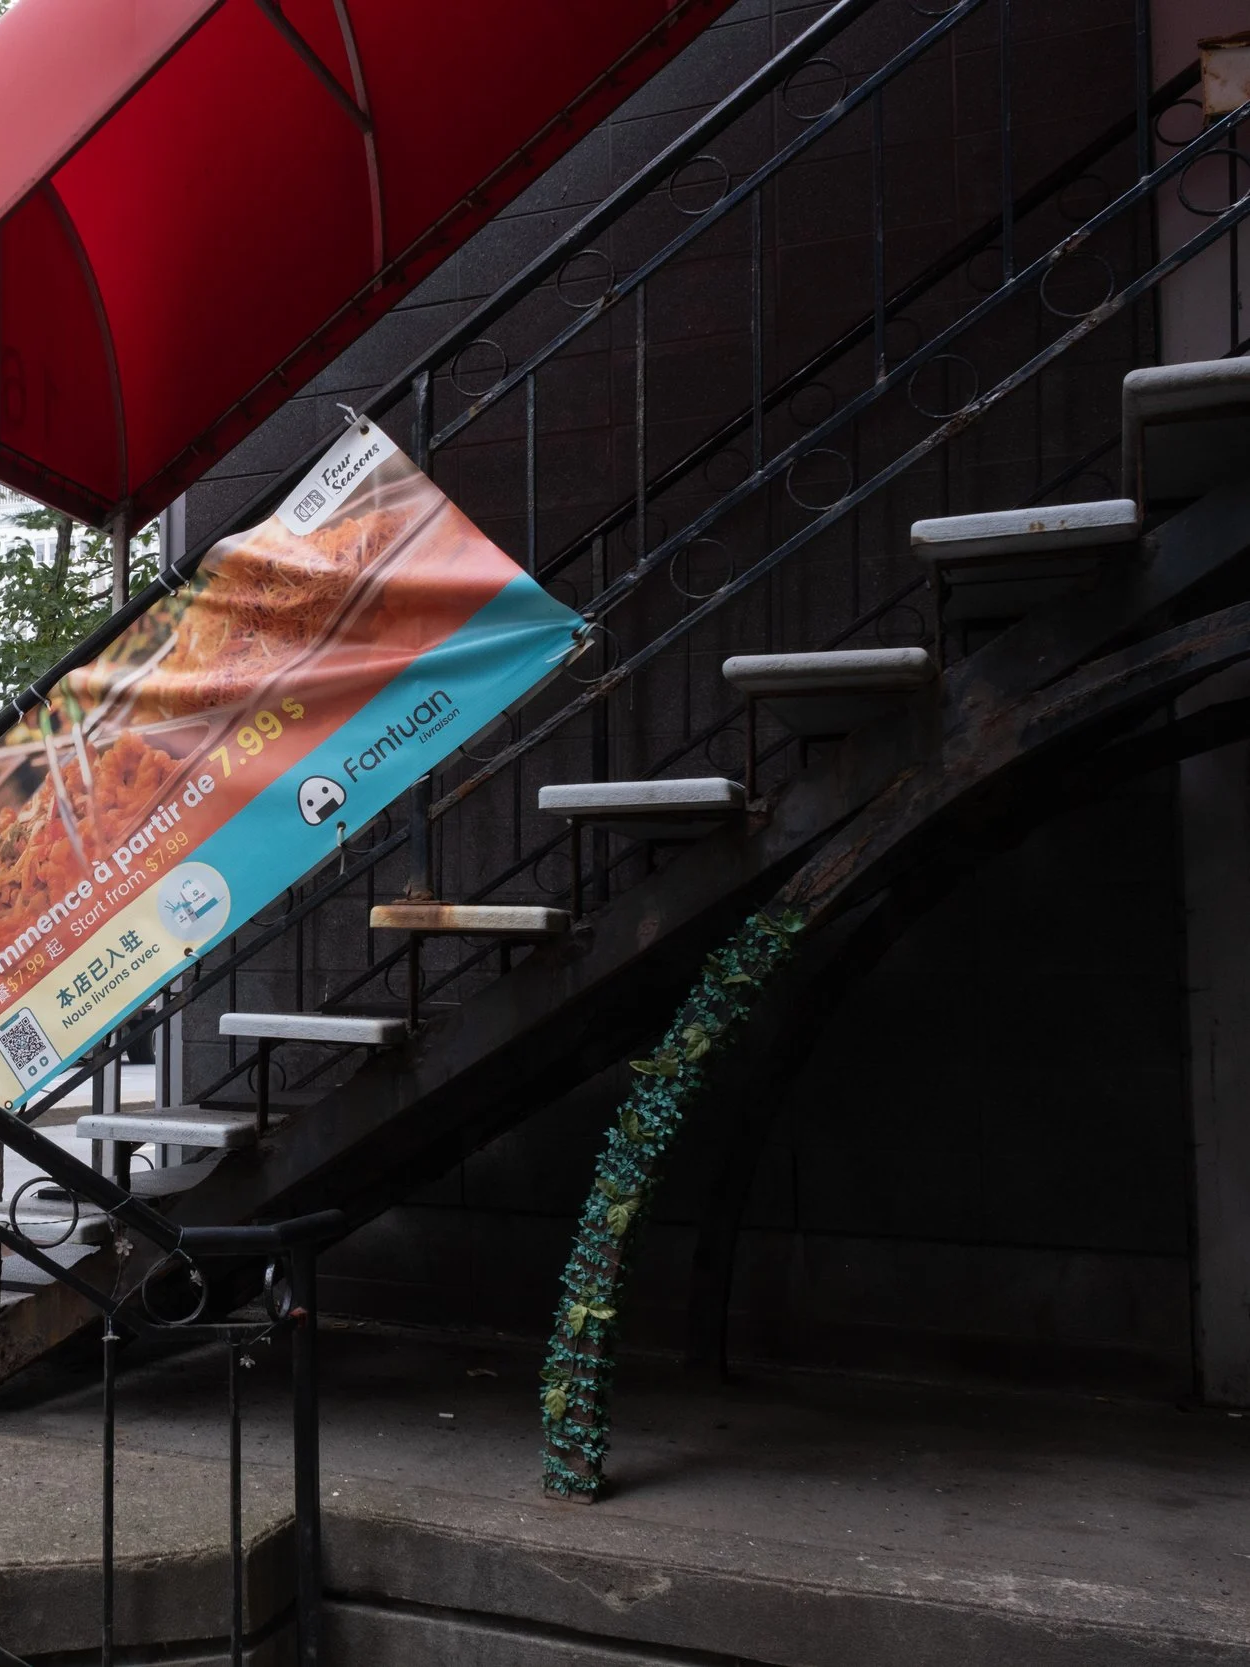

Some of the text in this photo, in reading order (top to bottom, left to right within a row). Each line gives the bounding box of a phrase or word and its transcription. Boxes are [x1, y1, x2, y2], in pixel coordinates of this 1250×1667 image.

[321, 453, 351, 486] Four
[331, 443, 380, 495] Seasons
[343, 690, 452, 783] Fantuan
[419, 708, 461, 744] Livraison
[92, 859, 114, 883] à
[112, 801, 182, 875] partir
[183, 774, 215, 808] de
[207, 710, 284, 778] 7.99
[70, 831, 189, 937] Start from $7.99
[61, 943, 161, 1029] Nous livrons avec
